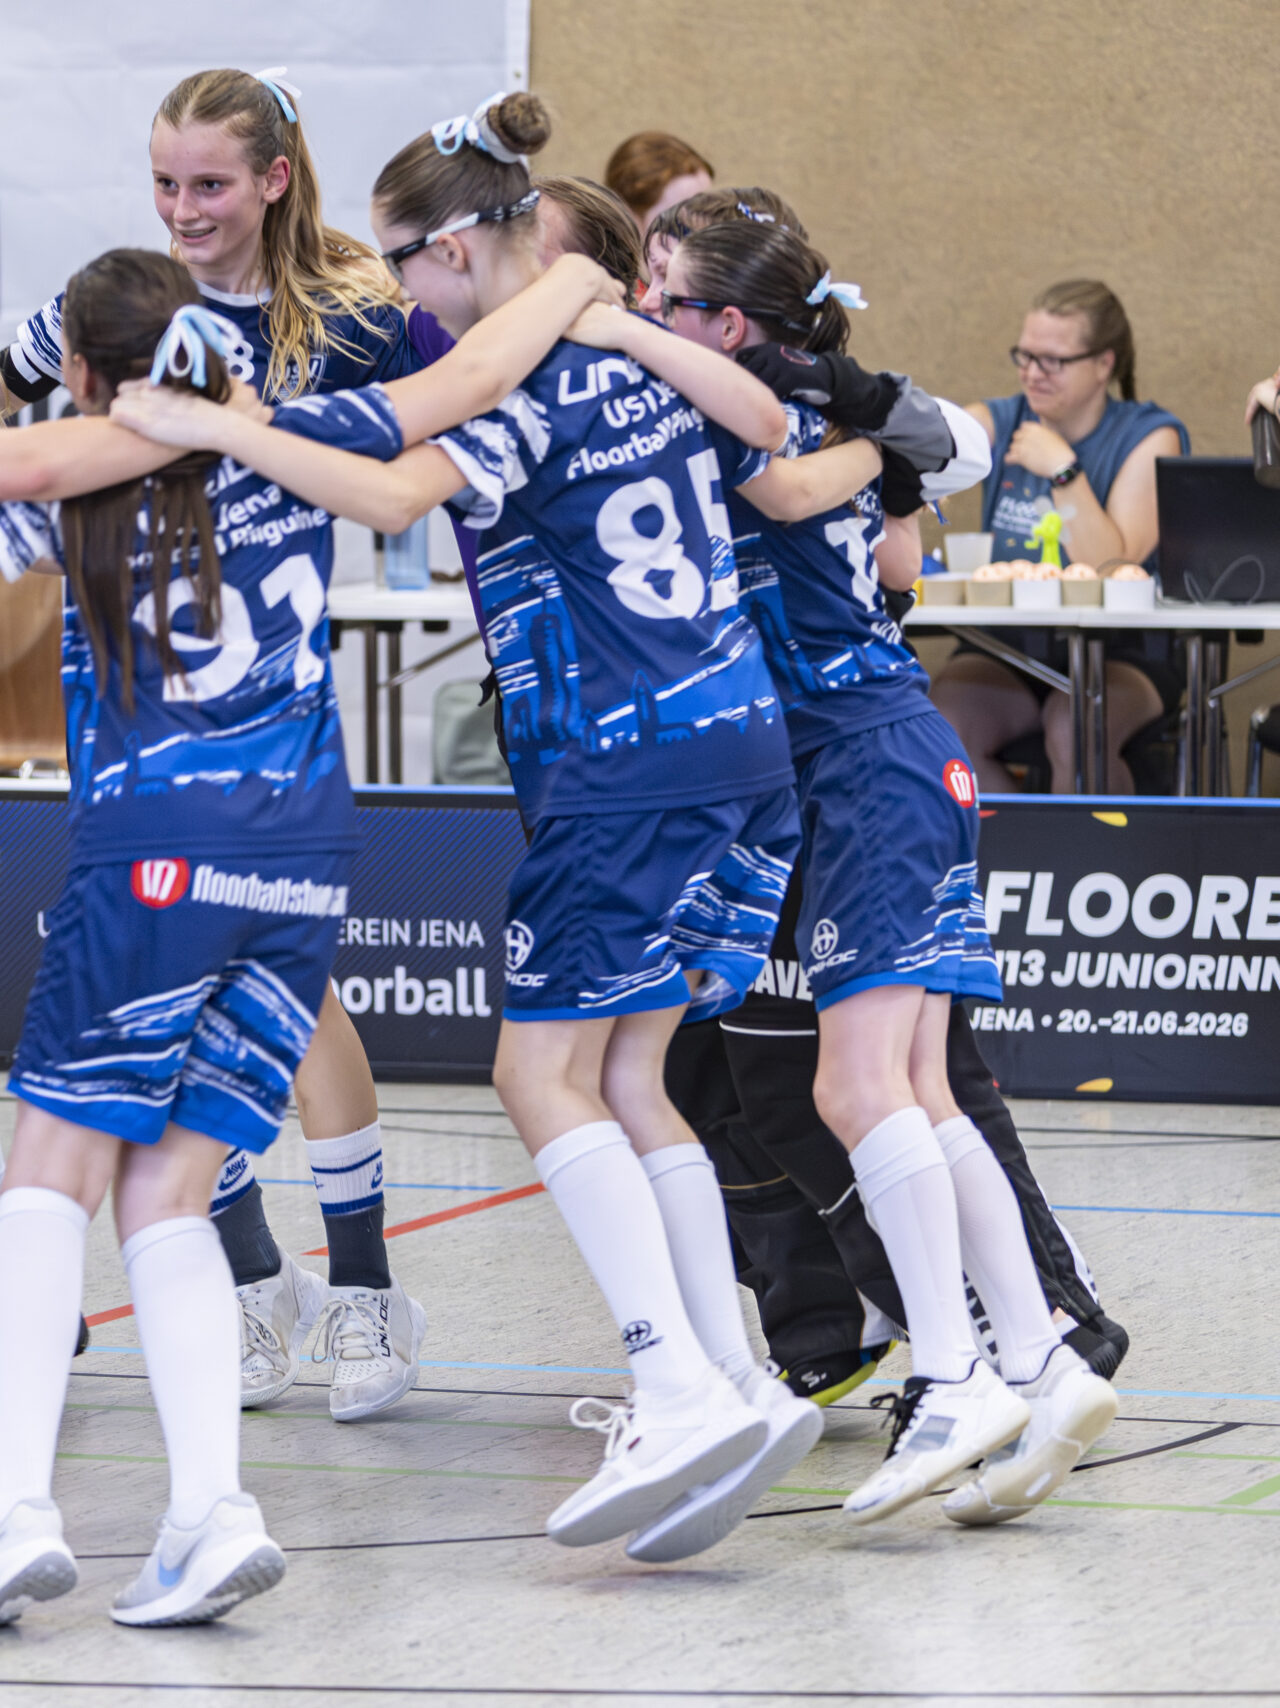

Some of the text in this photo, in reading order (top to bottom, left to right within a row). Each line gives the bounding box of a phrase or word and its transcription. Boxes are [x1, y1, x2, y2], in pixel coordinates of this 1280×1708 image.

[416, 918, 486, 949] JENA
[970, 1006, 1250, 1038] JENA 20.-21.06.2026
